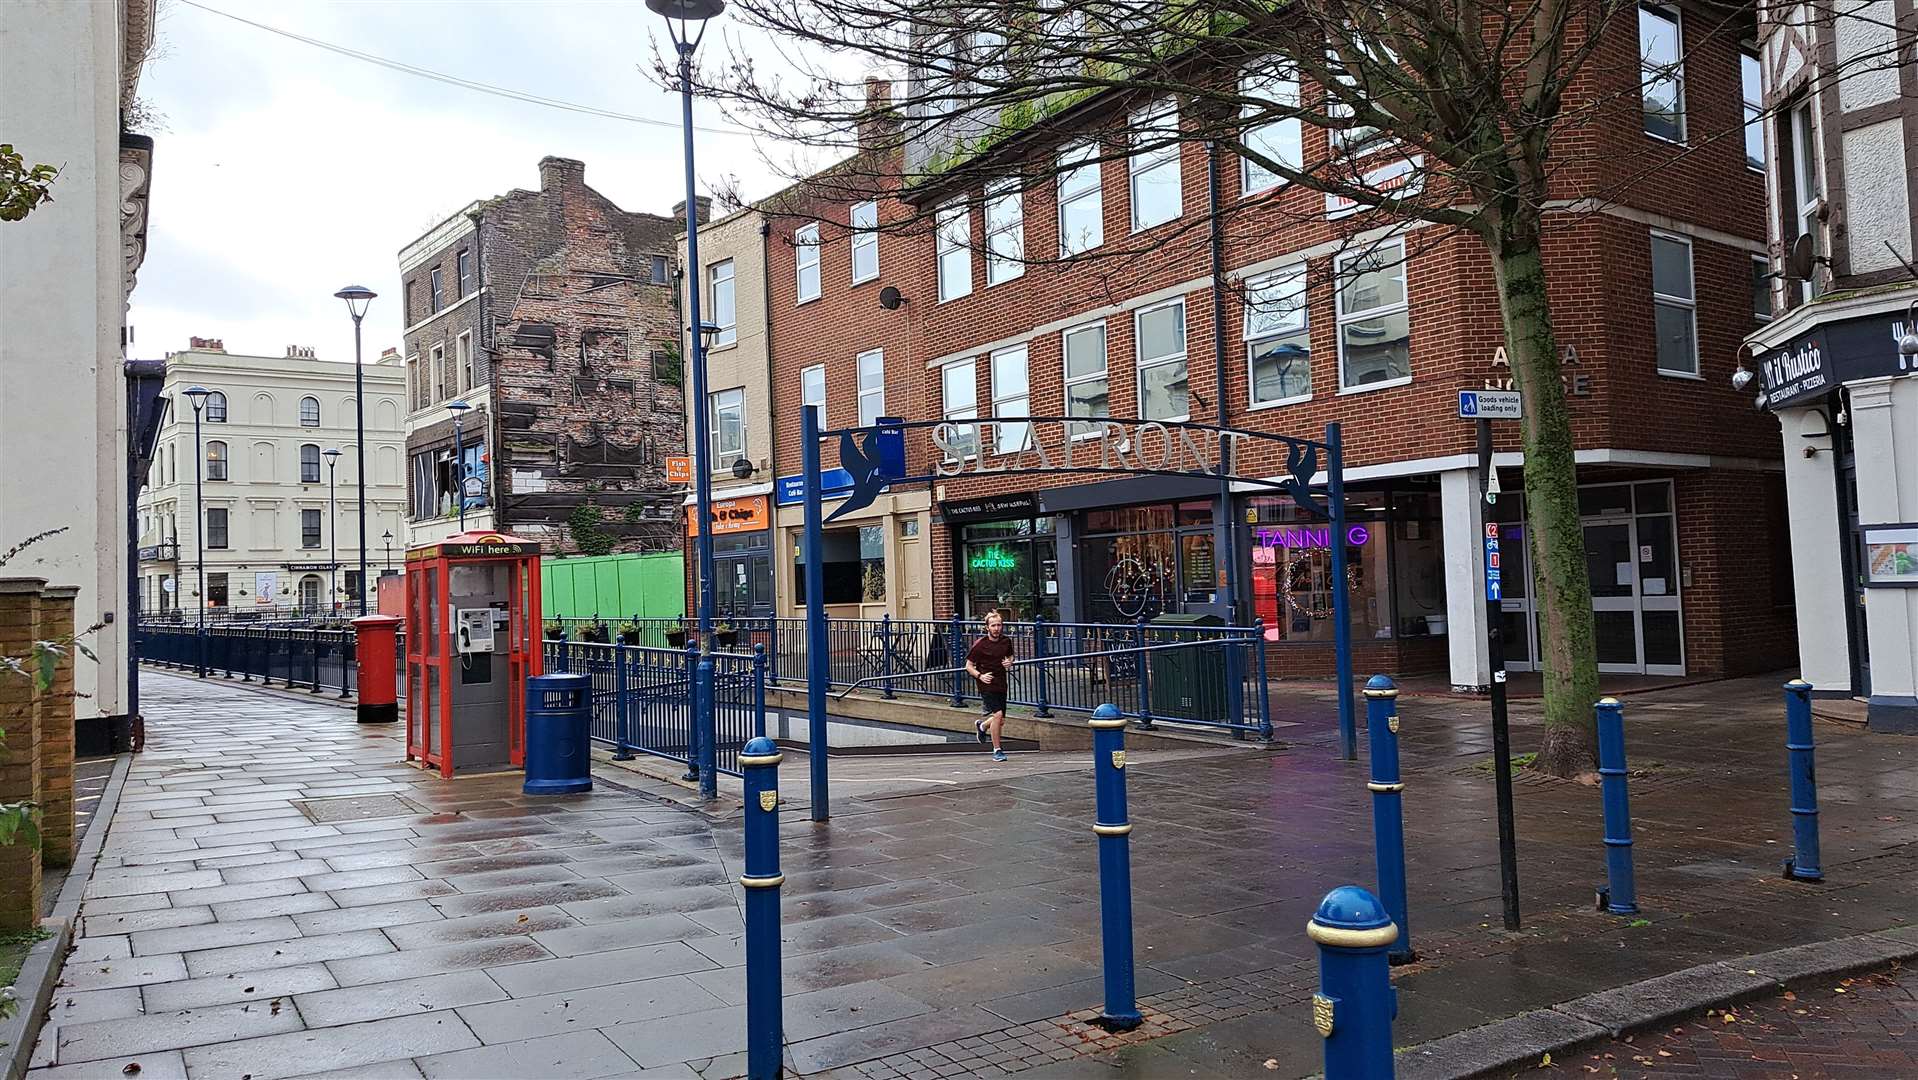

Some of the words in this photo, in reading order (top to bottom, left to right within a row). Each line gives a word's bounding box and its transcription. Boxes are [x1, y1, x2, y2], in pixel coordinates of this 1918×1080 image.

[1773, 357, 1784, 386] il
[1781, 342, 1821, 382] Rustico
[1769, 383, 1800, 404] RESTAURANT
[1802, 373, 1826, 390] PIZZERIA
[1478, 395, 1497, 403] Goods
[1499, 395, 1519, 403] vehicle
[1481, 404, 1503, 413] loading
[1504, 404, 1517, 413] only
[931, 419, 1250, 477] SEAFRONT
[716, 501, 736, 509] Europa
[728, 509, 754, 520] Chips
[1256, 524, 1369, 549] TANNIG
[461, 545, 484, 554] WiFi
[488, 544, 511, 554] here
[987, 550, 1000, 560] THE
[972, 559, 997, 568] CACTUS
[998, 559, 1015, 568] KISS
